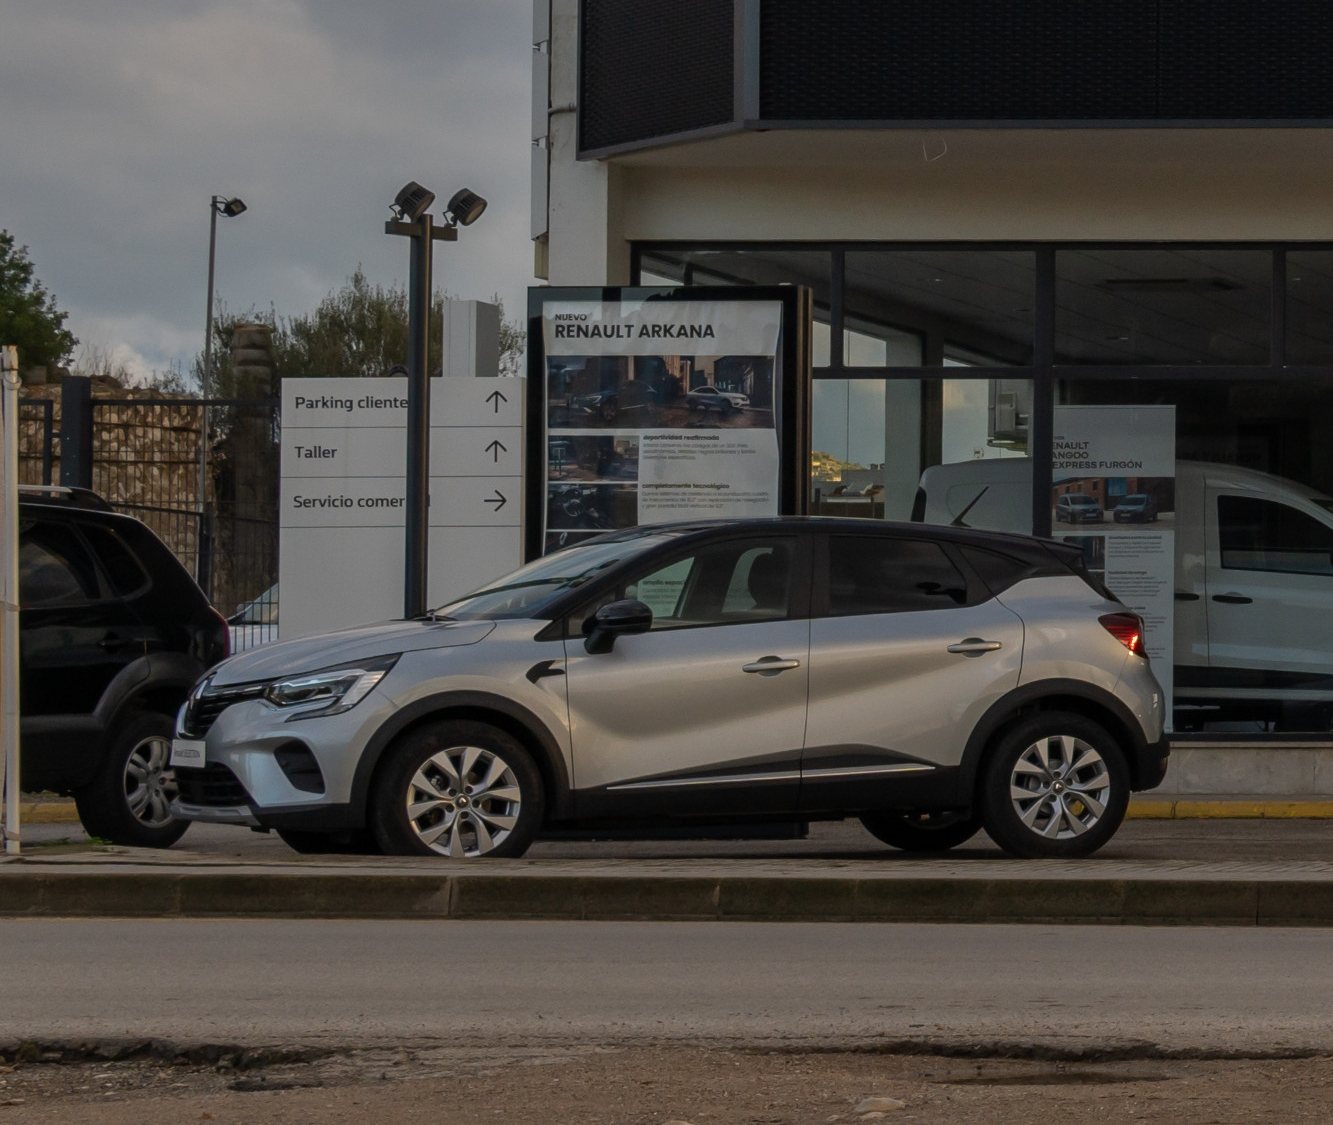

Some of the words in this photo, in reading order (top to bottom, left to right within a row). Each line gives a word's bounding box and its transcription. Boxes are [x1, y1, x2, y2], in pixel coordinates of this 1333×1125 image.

[554, 313, 588, 322] NUEVO
[554, 324, 635, 339] RENAULT
[637, 324, 715, 339] ARKANA
[295, 396, 354, 413] Parking
[1053, 441, 1090, 450] ENAULT
[294, 446, 338, 459] Taller
[1053, 451, 1089, 460] ANGOO
[1098, 459, 1143, 470] FURGÓN
[293, 494, 354, 509] Servicio
